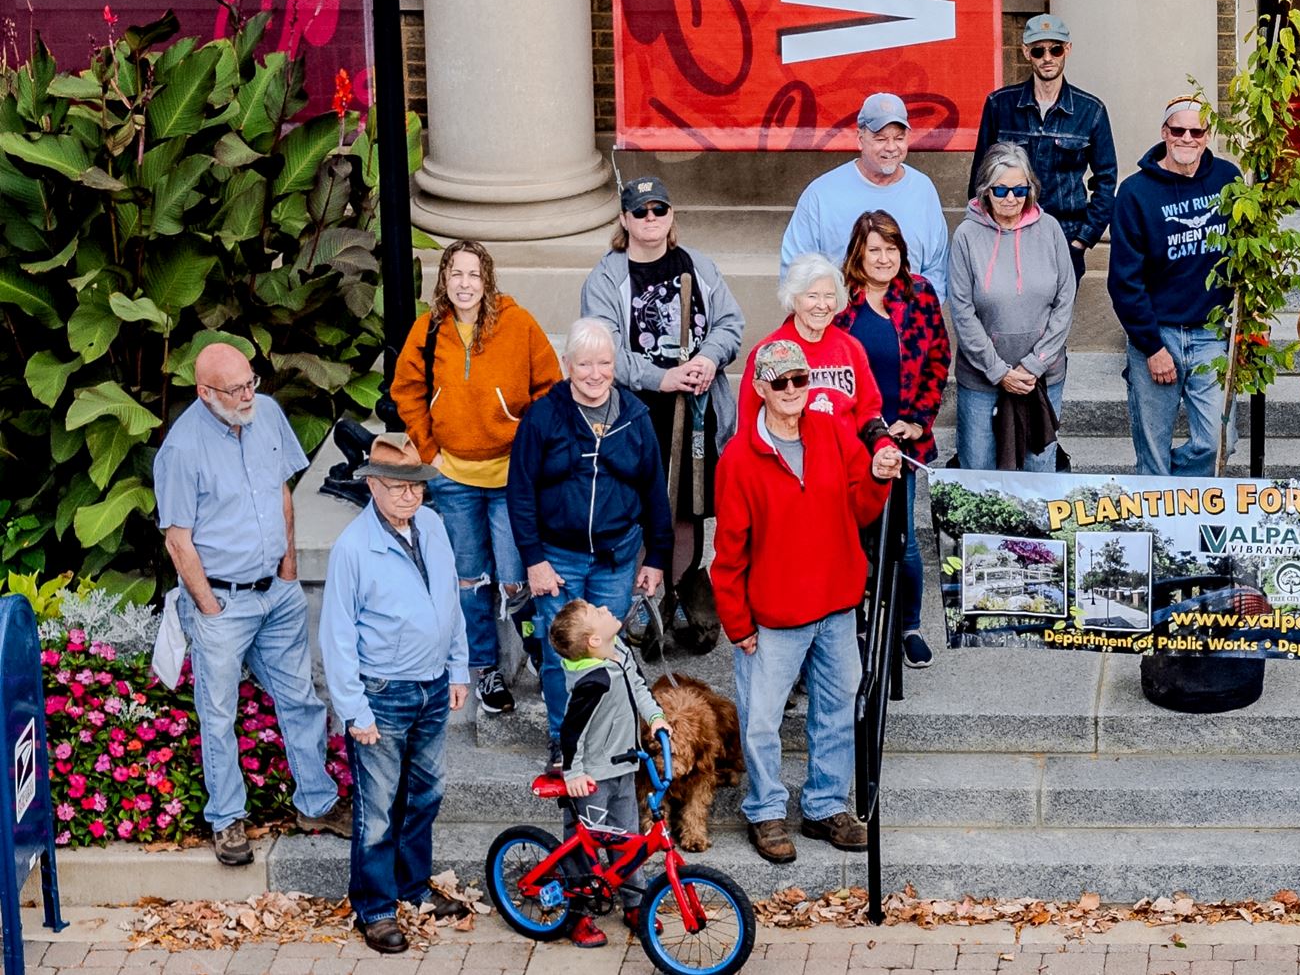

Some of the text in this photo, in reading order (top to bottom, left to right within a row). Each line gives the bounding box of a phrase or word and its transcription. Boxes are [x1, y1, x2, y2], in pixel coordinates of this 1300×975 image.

[1161, 200, 1189, 218] WHY
[1167, 228, 1202, 246] WHEN
[1167, 242, 1197, 260] CAN
[1047, 487, 1226, 530] PLANTING
[1231, 544, 1294, 555] VIBRANT
[1044, 629, 1132, 649] Department
[1138, 635, 1154, 648] of
[1158, 636, 1203, 650] Public
[1208, 637, 1258, 651] Works
